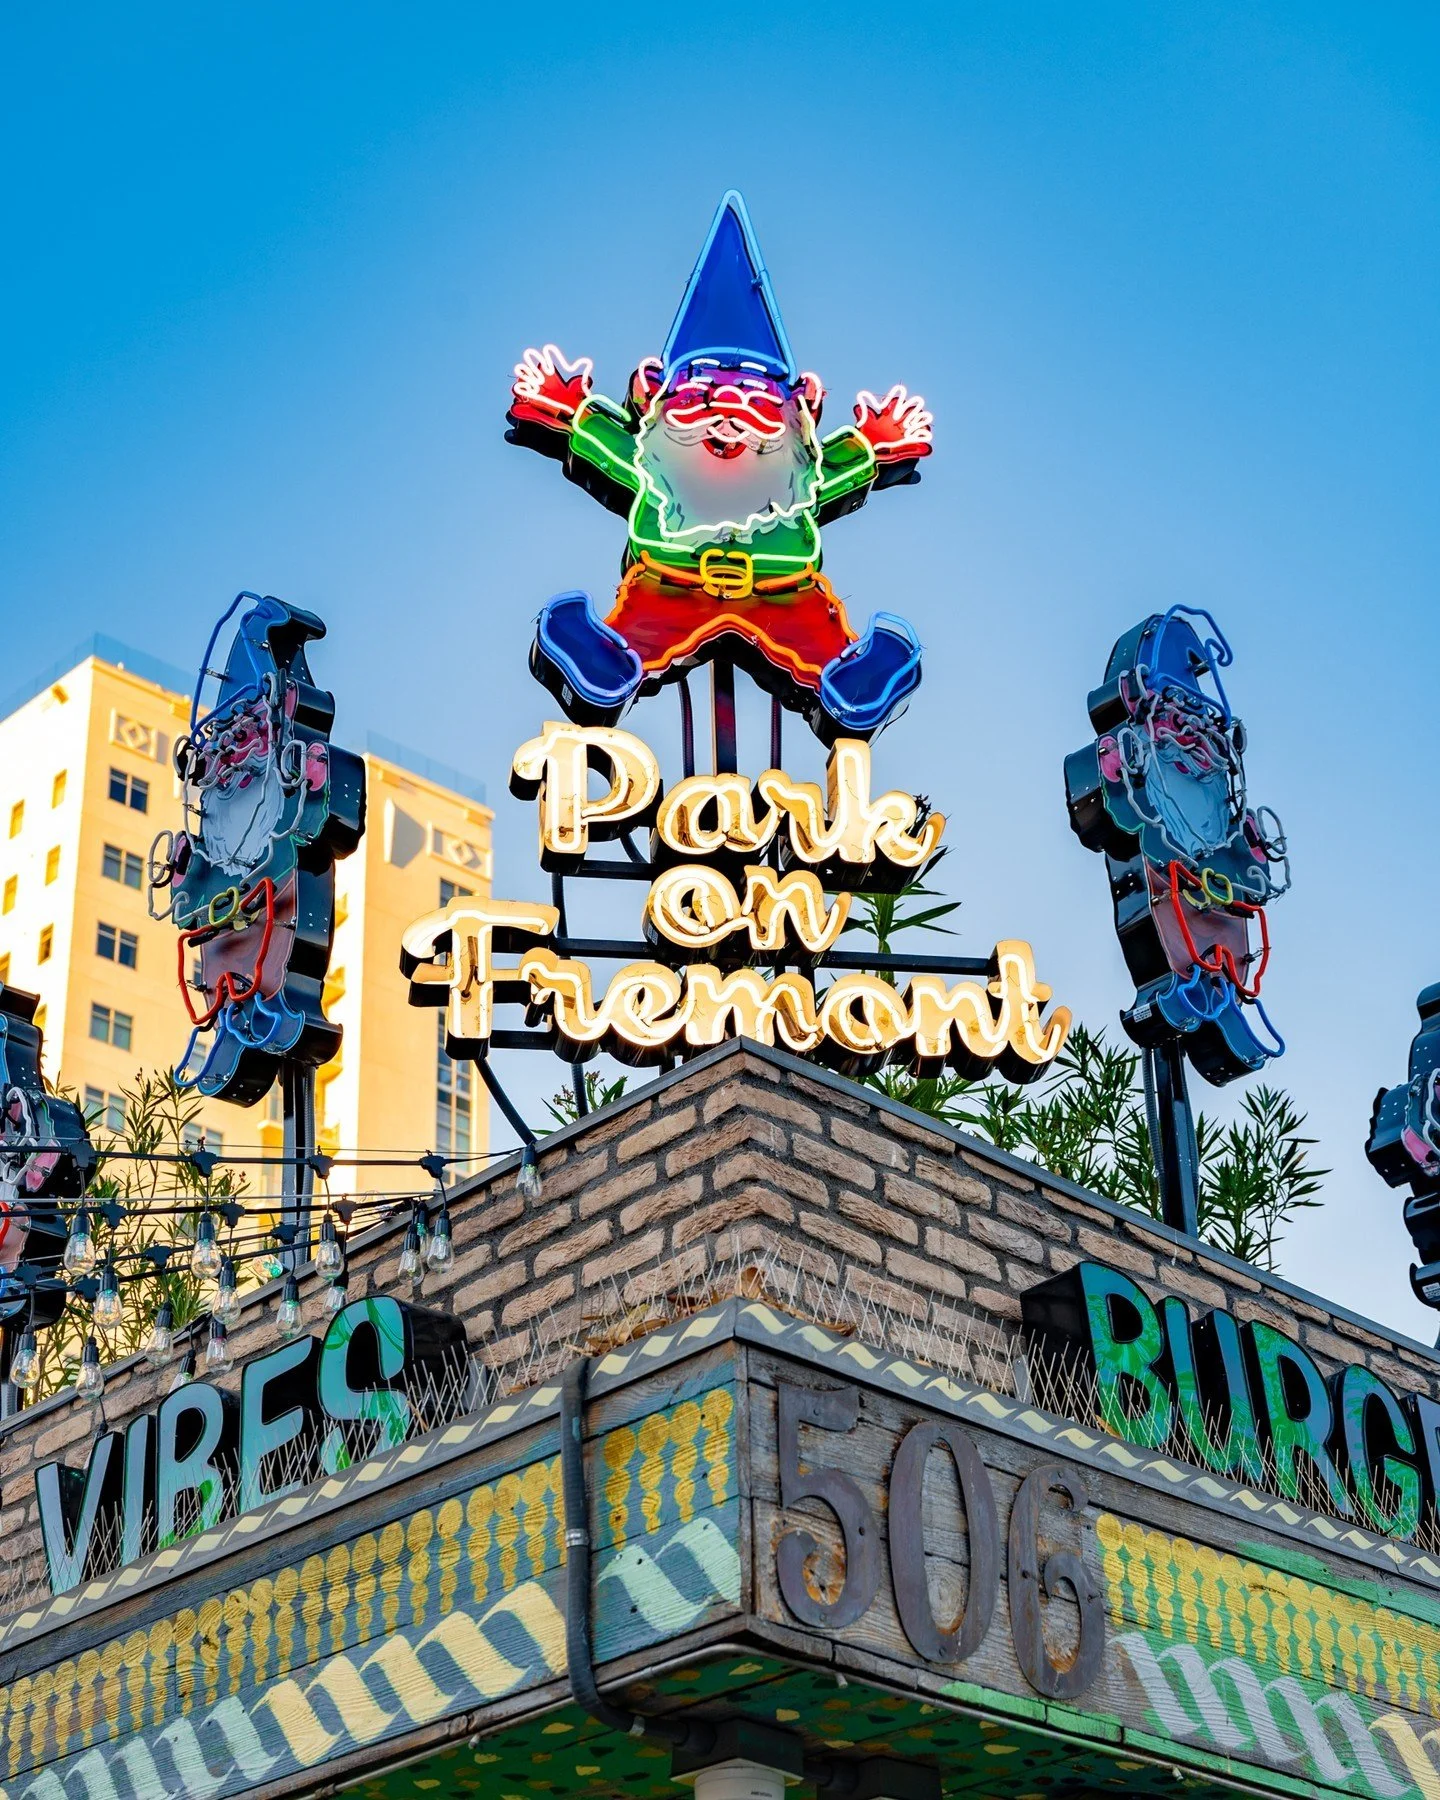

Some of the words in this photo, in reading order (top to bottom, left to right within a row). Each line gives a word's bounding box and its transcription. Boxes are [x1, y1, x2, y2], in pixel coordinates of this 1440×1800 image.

[511, 721, 946, 867] Park
[401, 896, 1072, 1066] Fremont
[35, 1295, 412, 1595] VIBES
[777, 1384, 1105, 1699] 506
